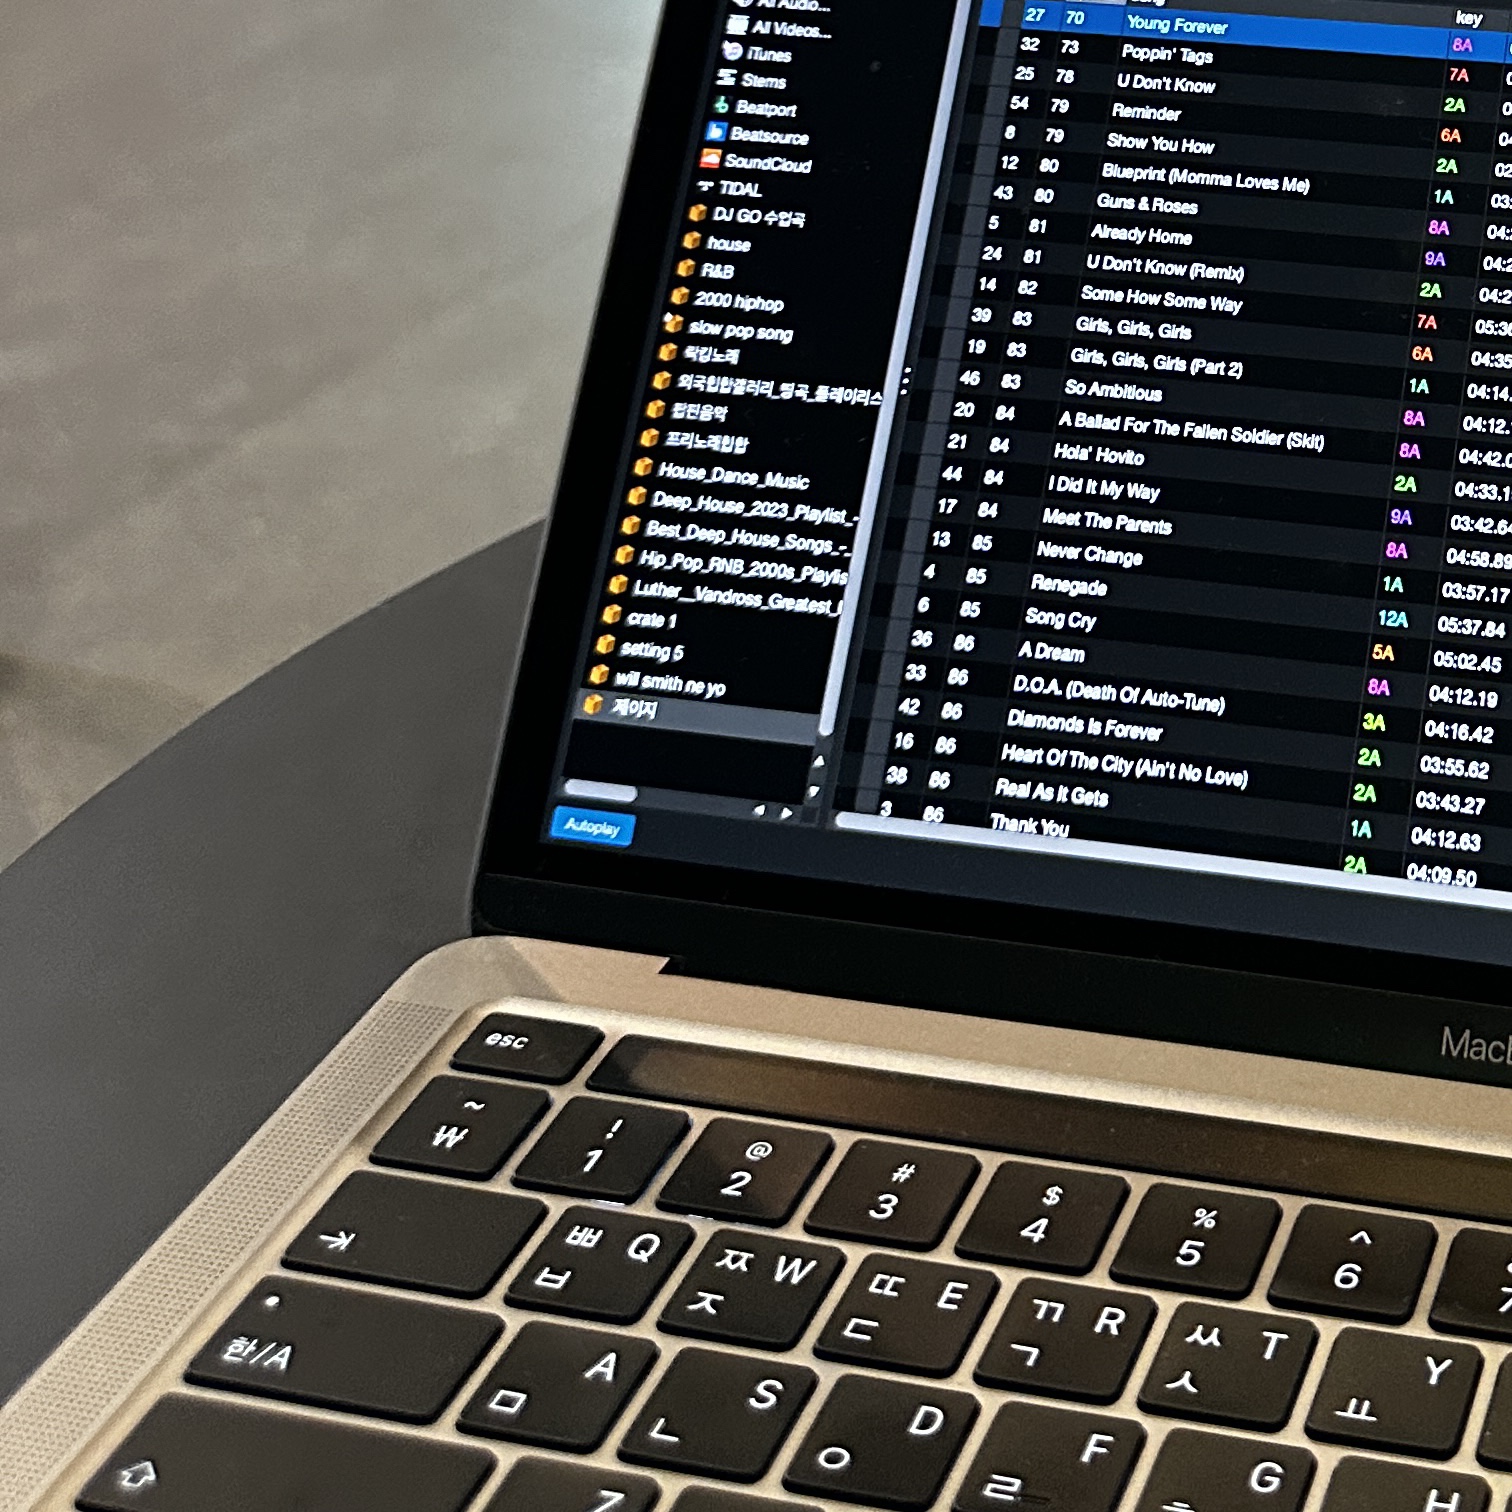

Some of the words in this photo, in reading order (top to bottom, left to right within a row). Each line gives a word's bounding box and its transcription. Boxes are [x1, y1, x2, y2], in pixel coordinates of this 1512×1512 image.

[1025, 7, 1045, 21] 27
[1066, 10, 1085, 25] 70
[1455, 9, 1483, 31] key
[1127, 14, 1170, 34] Young
[1173, 17, 1228, 35] Forever
[1020, 36, 1040, 51] 32
[1061, 39, 1079, 54] 73
[1452, 37, 1472, 52] 8A
[746, 46, 792, 63] iTunes
[1121, 43, 1177, 62] Poppin'
[1180, 47, 1213, 66] Tags
[741, 72, 786, 89] Stems
[1450, 67, 1469, 82] 7A
[735, 99, 797, 118] Beatport
[1010, 95, 1029, 110] 54
[1050, 98, 1070, 113] 79
[1111, 102, 1182, 121] Reminder
[729, 126, 809, 146] Beatsource
[1440, 127, 1461, 143] 6A
[724, 153, 812, 174] SoundCloud
[719, 179, 763, 198] TIDAL
[712, 206, 734, 221] DJ
[736, 208, 762, 224] GO
[763, 210, 806, 228] 수업곡
[988, 215, 999, 230] 5
[1028, 218, 1047, 234] 81
[706, 235, 751, 252] house
[1090, 223, 1147, 245] Already
[1147, 227, 1193, 246] Home
[1425, 251, 1446, 266] 9A
[700, 262, 735, 280] R&B
[693, 290, 733, 308] 2000
[732, 294, 784, 314] hiphop
[688, 319, 724, 335] slow
[723, 324, 755, 340] pop
[755, 327, 794, 345] song
[959, 369, 980, 386] 46
[1000, 373, 1021, 390] 83
[1064, 378, 1086, 396] So
[1087, 381, 1163, 402] Ambitious
[1403, 409, 1425, 427] 8A
[658, 461, 810, 490] House_Dance_Music
[923, 563, 935, 579] 4
[965, 567, 987, 584] 85
[1030, 573, 1108, 597] Renegade
[626, 612, 665, 628] crate
[669, 613, 677, 629] 1
[1379, 609, 1409, 628] 12A
[1437, 615, 1506, 639] 05:37.84
[620, 641, 671, 663] setting
[672, 644, 685, 662] 5
[614, 670, 641, 687] will
[640, 674, 683, 692] smith
[683, 679, 706, 695] ne
[704, 682, 726, 699] yo
[564, 817, 620, 839] Autoplay
[485, 1033, 528, 1049] esc
[584, 1150, 603, 1172] 1
[721, 1171, 750, 1196] 2
[869, 1194, 898, 1219] 3
[1020, 1218, 1048, 1242] 4
[627, 1234, 660, 1262] Q
[1176, 1240, 1204, 1265] 5
[775, 1256, 817, 1284] W
[1335, 1264, 1361, 1288] 6
[937, 1282, 968, 1309] E
[1094, 1307, 1125, 1335] R
[222, 1337, 291, 1370] 한/A
[1263, 1332, 1289, 1359] T
[1427, 1356, 1452, 1384] Y
